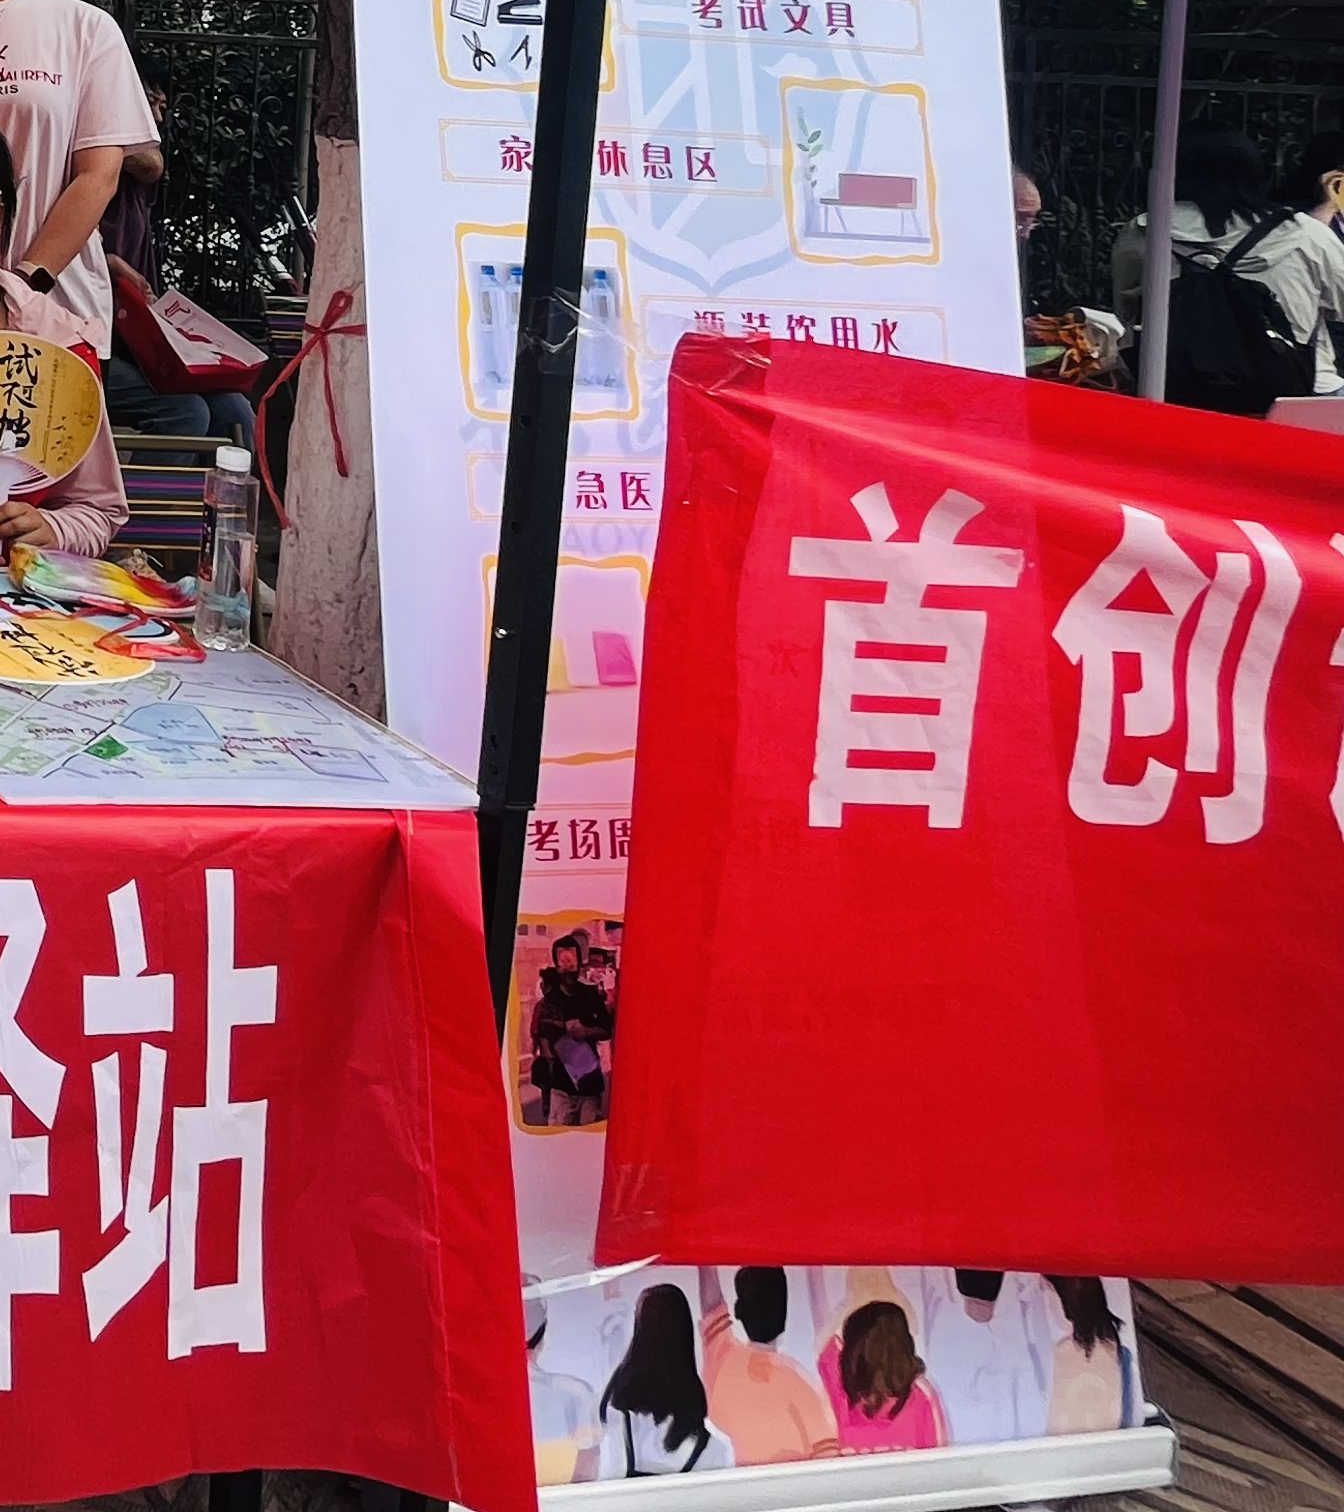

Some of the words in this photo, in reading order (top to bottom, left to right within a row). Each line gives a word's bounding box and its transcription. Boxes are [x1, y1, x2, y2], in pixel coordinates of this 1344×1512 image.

[499, 135, 719, 182] 家休息区
[576, 470, 654, 510] 急医
[788, 482, 1344, 846] 首创
[527, 819, 632, 861] 考场周
